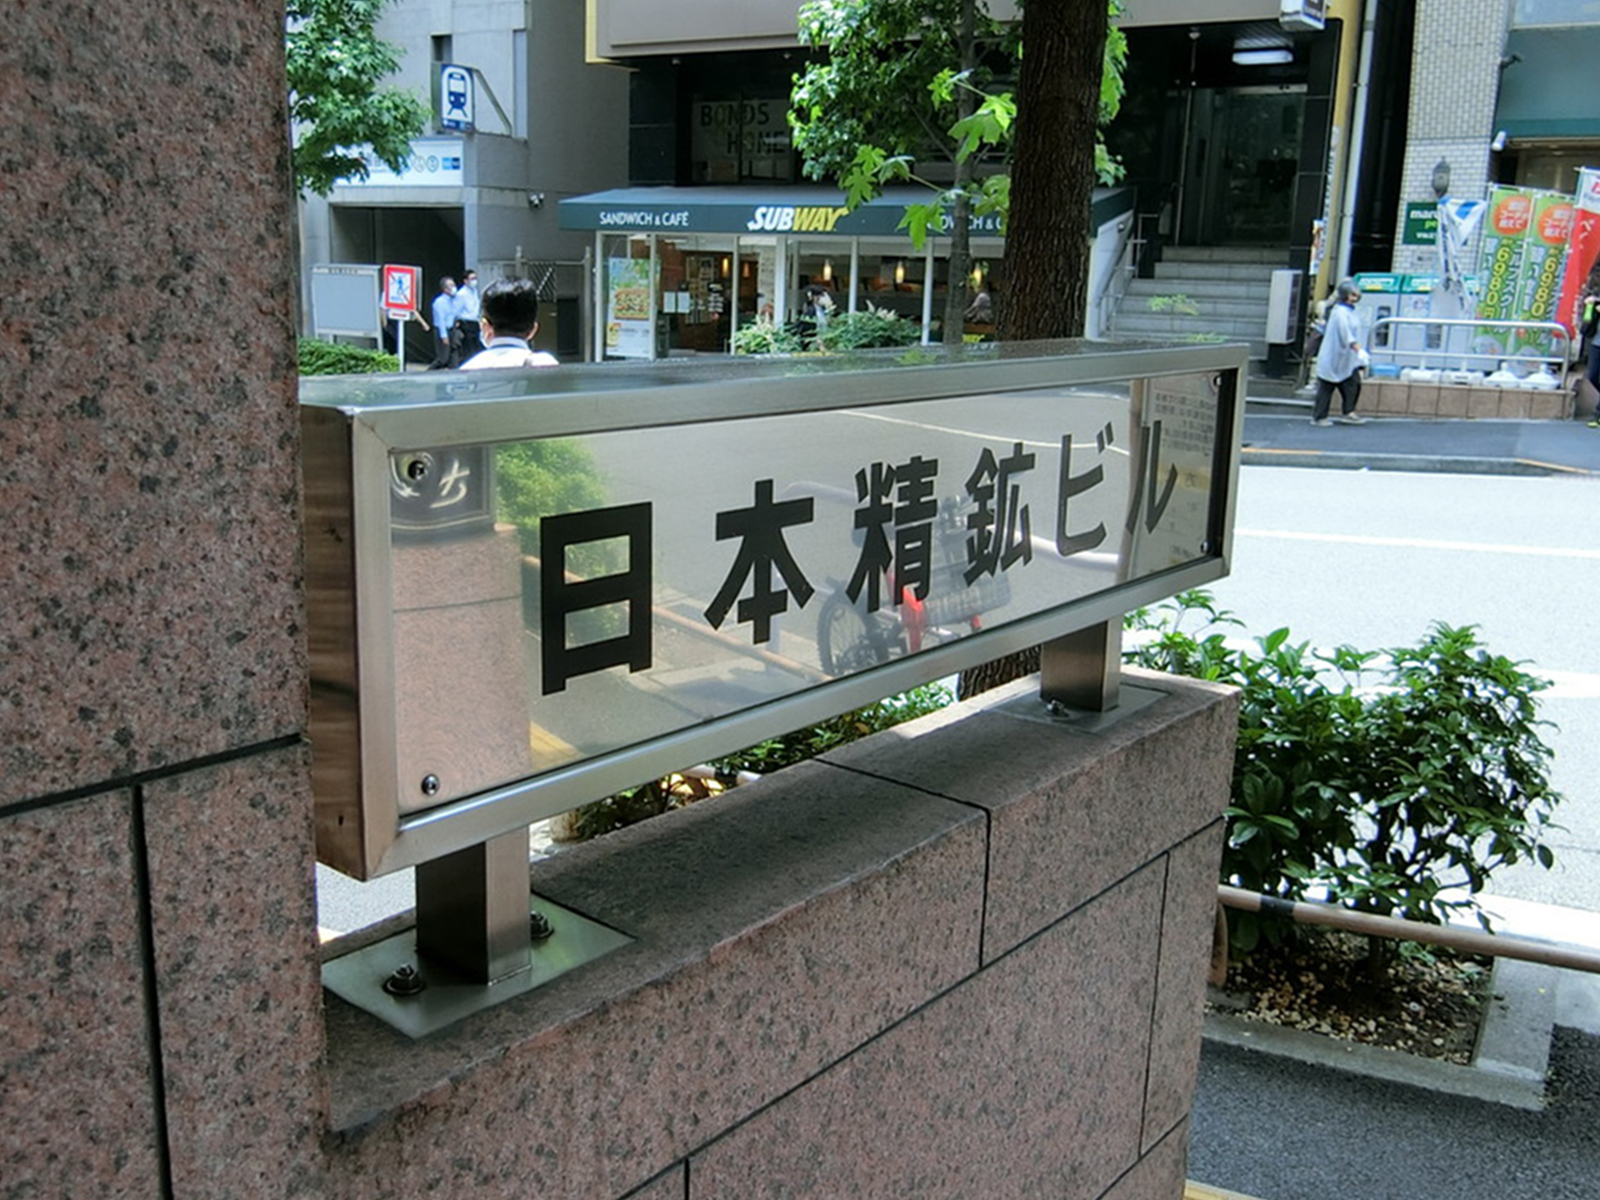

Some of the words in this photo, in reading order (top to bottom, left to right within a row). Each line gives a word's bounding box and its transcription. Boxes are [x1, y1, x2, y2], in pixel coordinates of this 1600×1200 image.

[701, 102, 770, 126] BONDS
[727, 131, 785, 154] HOME
[600, 211, 651, 226] SANDWICH
[654, 215, 661, 226] &
[662, 210, 689, 227] CAFÉ
[747, 206, 849, 231] SUBWAY
[540, 421, 1179, 697] 日本精鉱ビル
